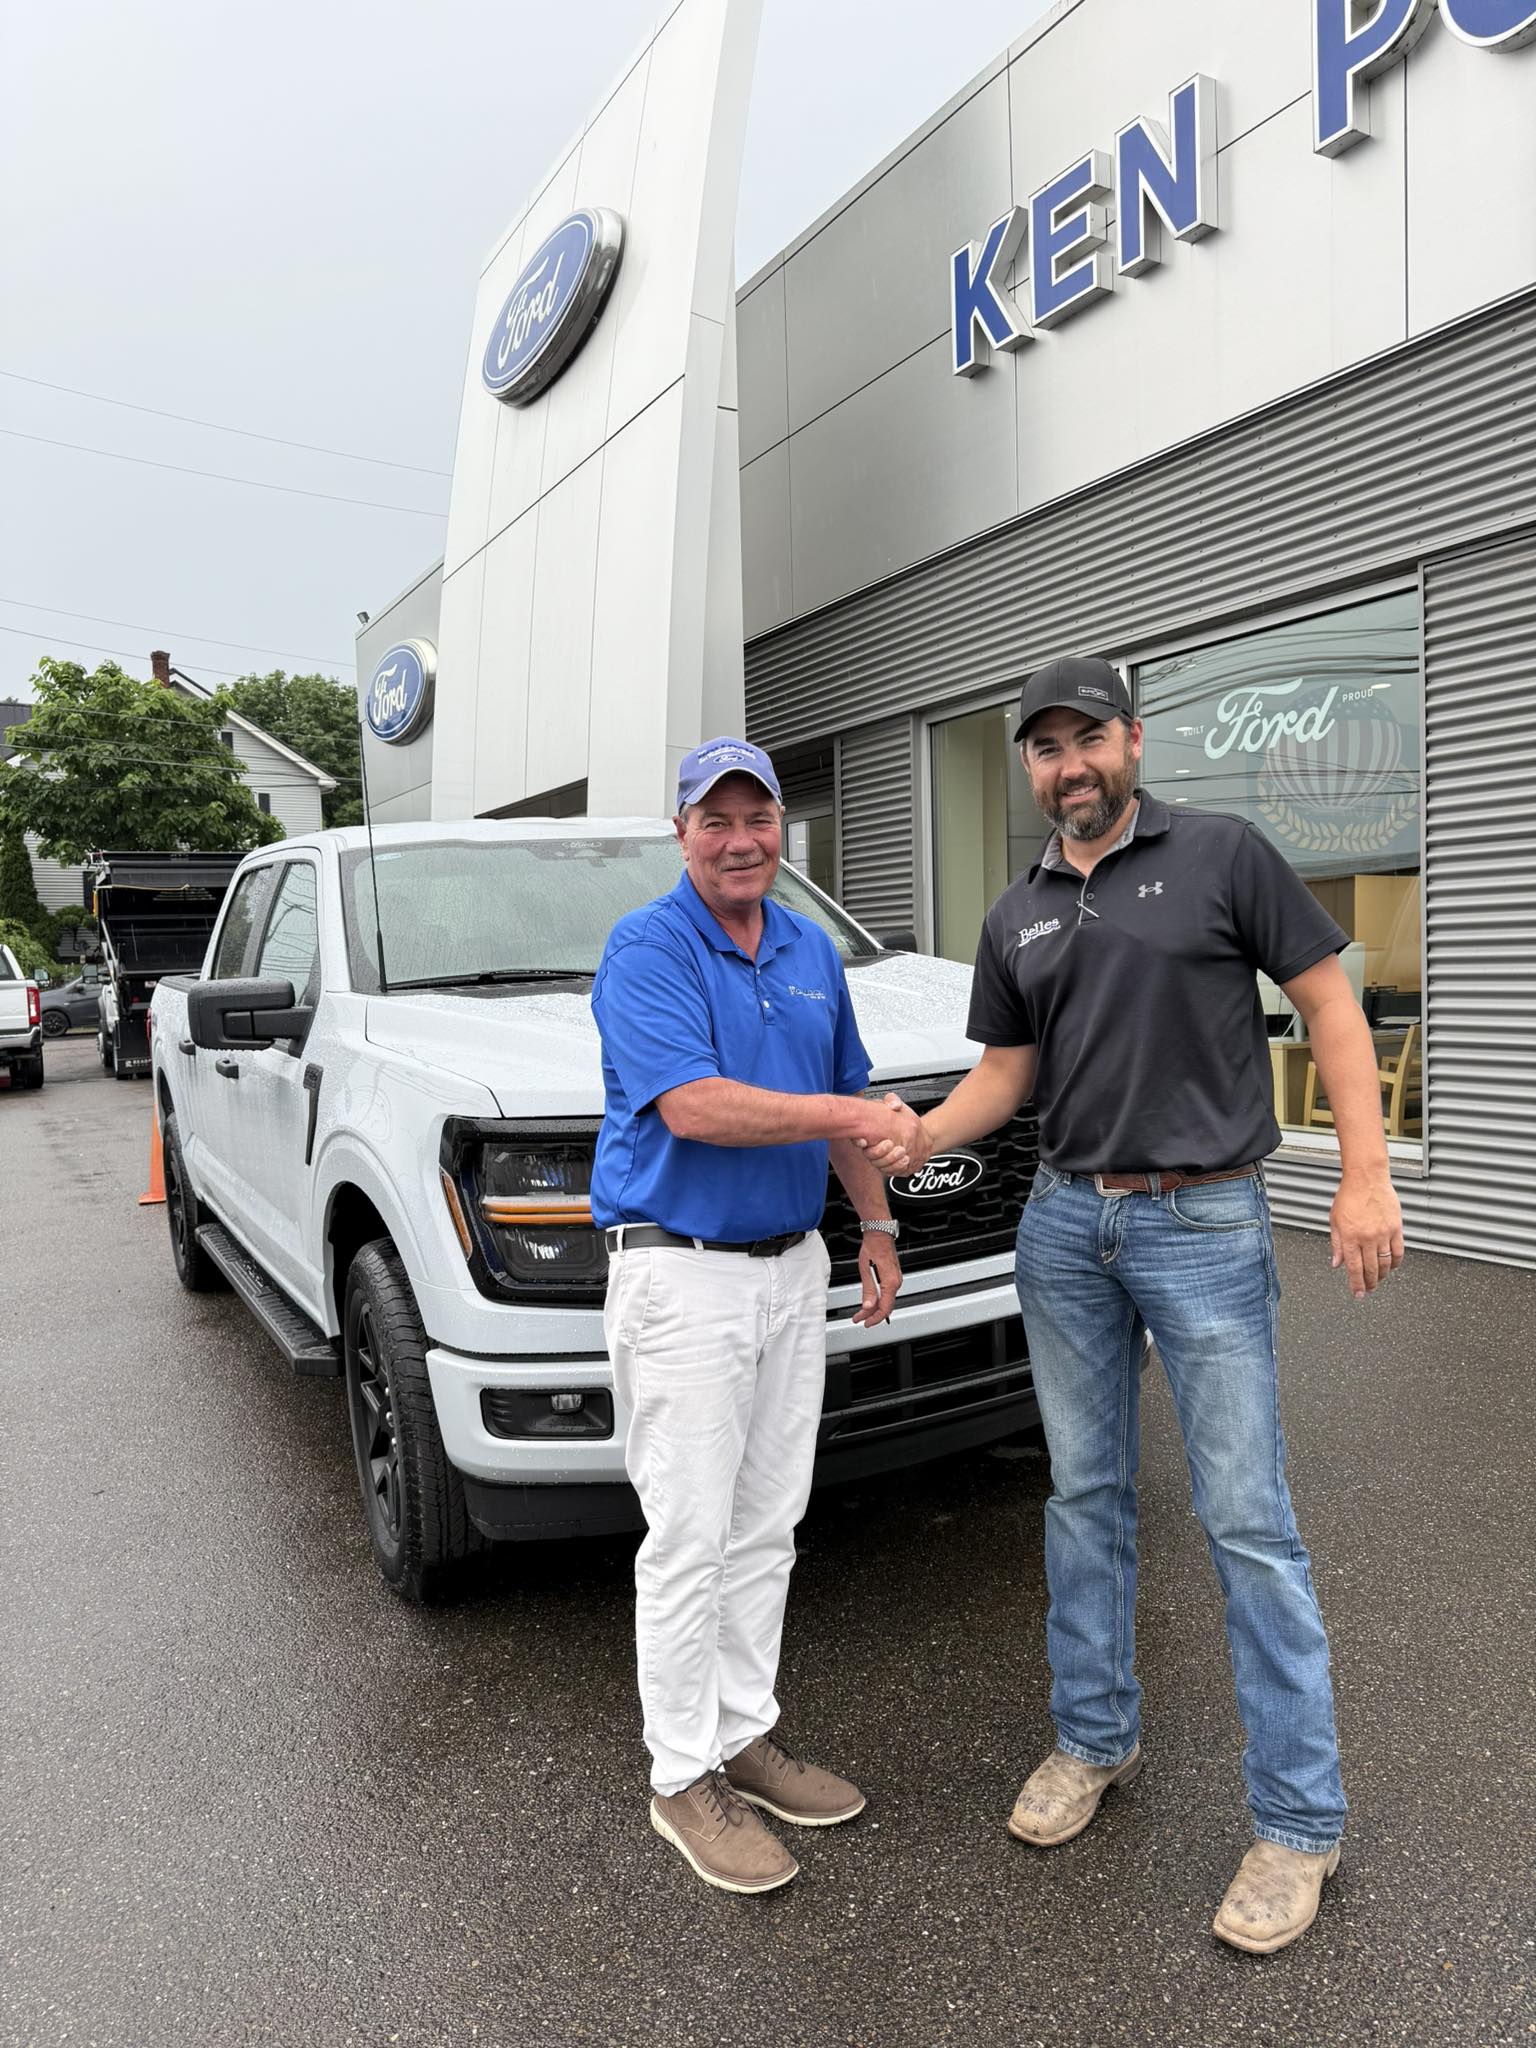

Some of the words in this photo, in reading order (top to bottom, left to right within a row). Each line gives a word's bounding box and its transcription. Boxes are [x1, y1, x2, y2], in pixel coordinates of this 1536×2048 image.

[951, 73, 1216, 378] KEN
[1313, 0, 1536, 157] P
[498, 251, 565, 370] Ford
[373, 663, 407, 726] Ford
[1204, 677, 1339, 760] Ford
[1342, 688, 1374, 703] PROUD
[1018, 918, 1061, 947] Belles
[908, 1160, 965, 1193] Ford
